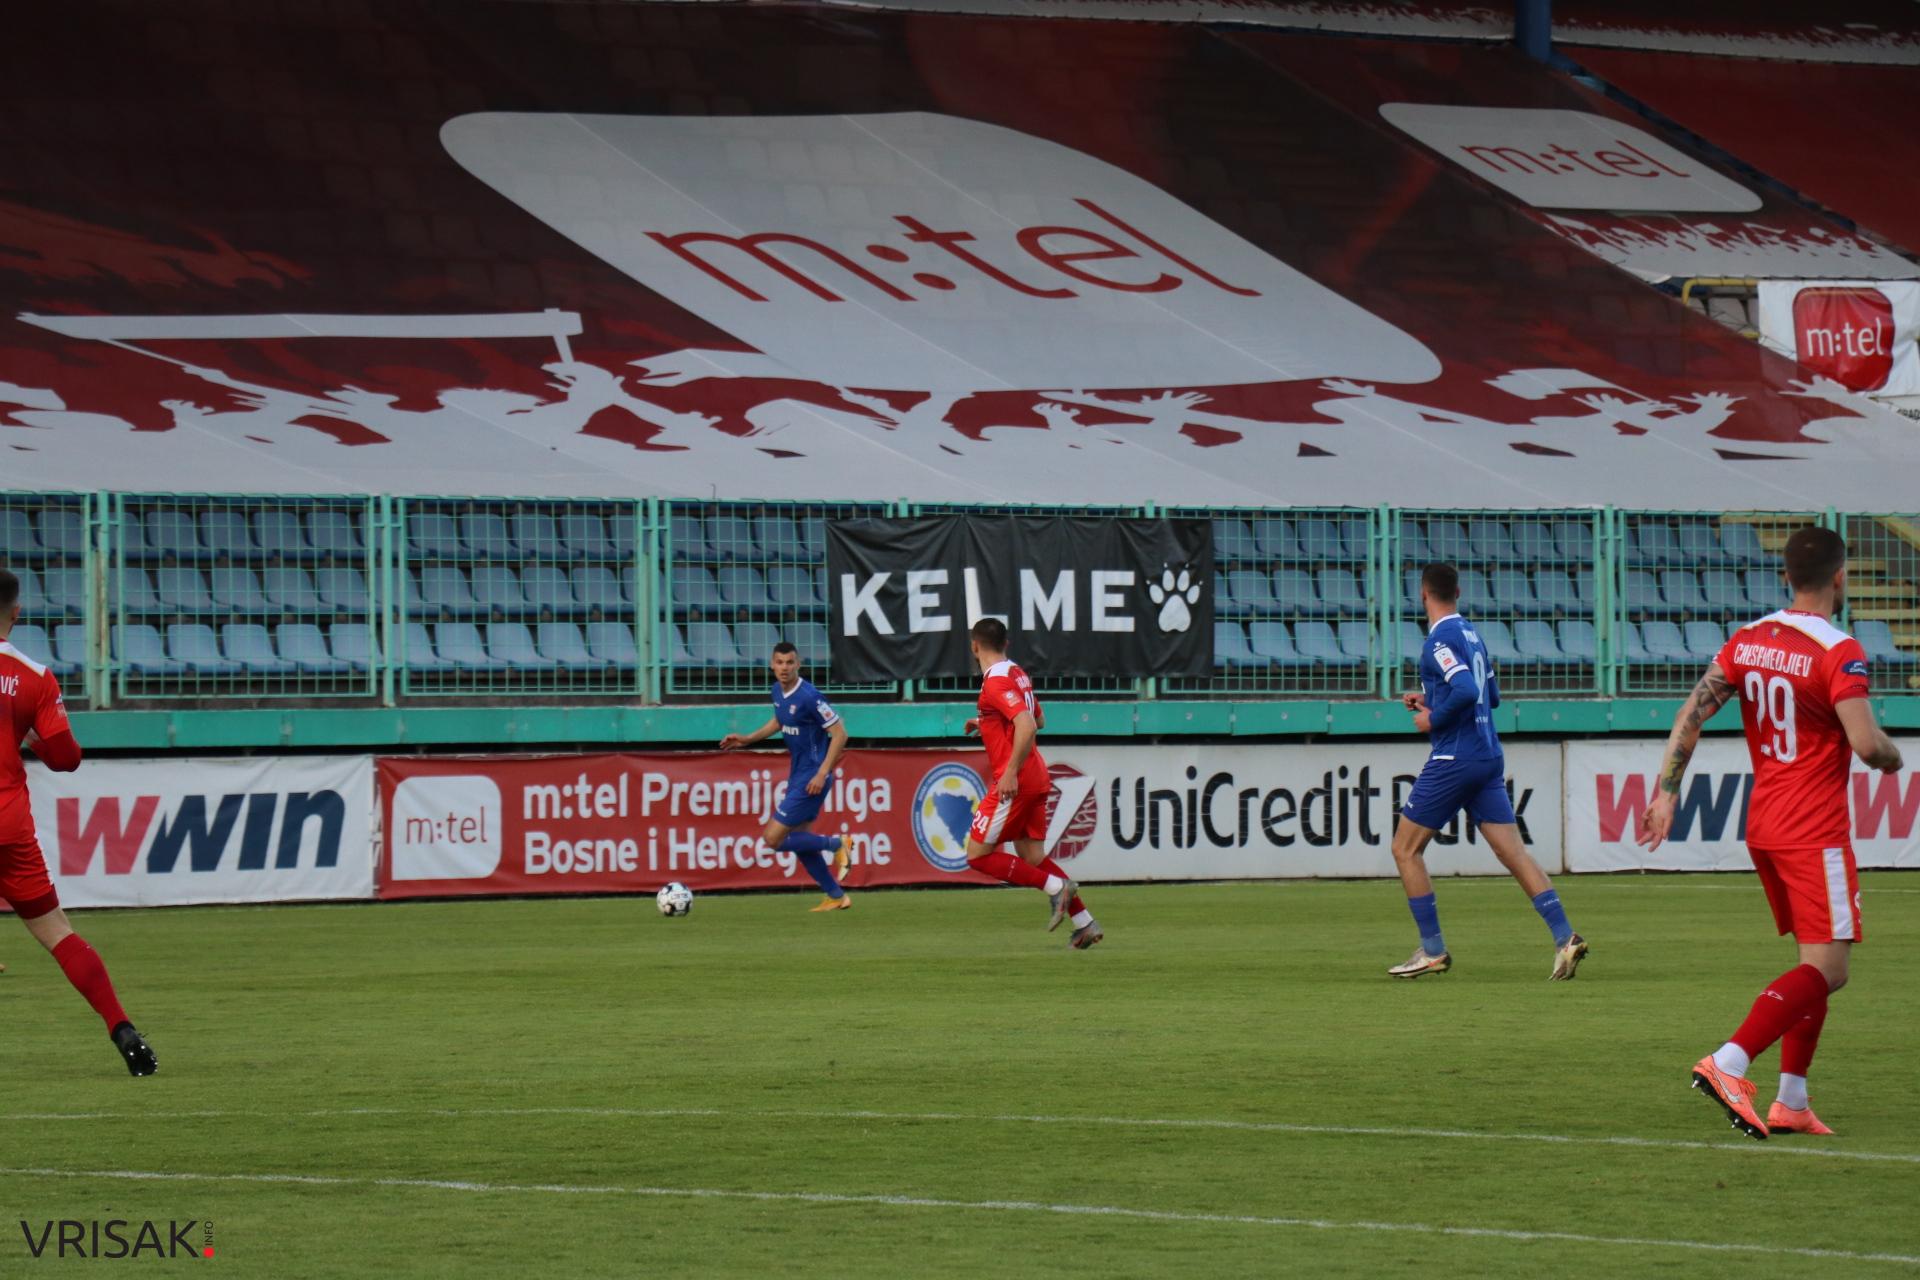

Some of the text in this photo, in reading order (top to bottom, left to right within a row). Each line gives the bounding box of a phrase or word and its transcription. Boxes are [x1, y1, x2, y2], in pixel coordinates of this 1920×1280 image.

[1460, 140, 1691, 178] m:tel
[643, 198, 1263, 302] m:tel
[1806, 317, 1883, 358] m:tel
[841, 567, 1135, 636] KELME
[524, 773, 628, 819] m:tel
[1111, 765, 1381, 850] UniCredit
[406, 805, 487, 844] m:tel
[525, 822, 892, 877] Bosne i Hercegne
